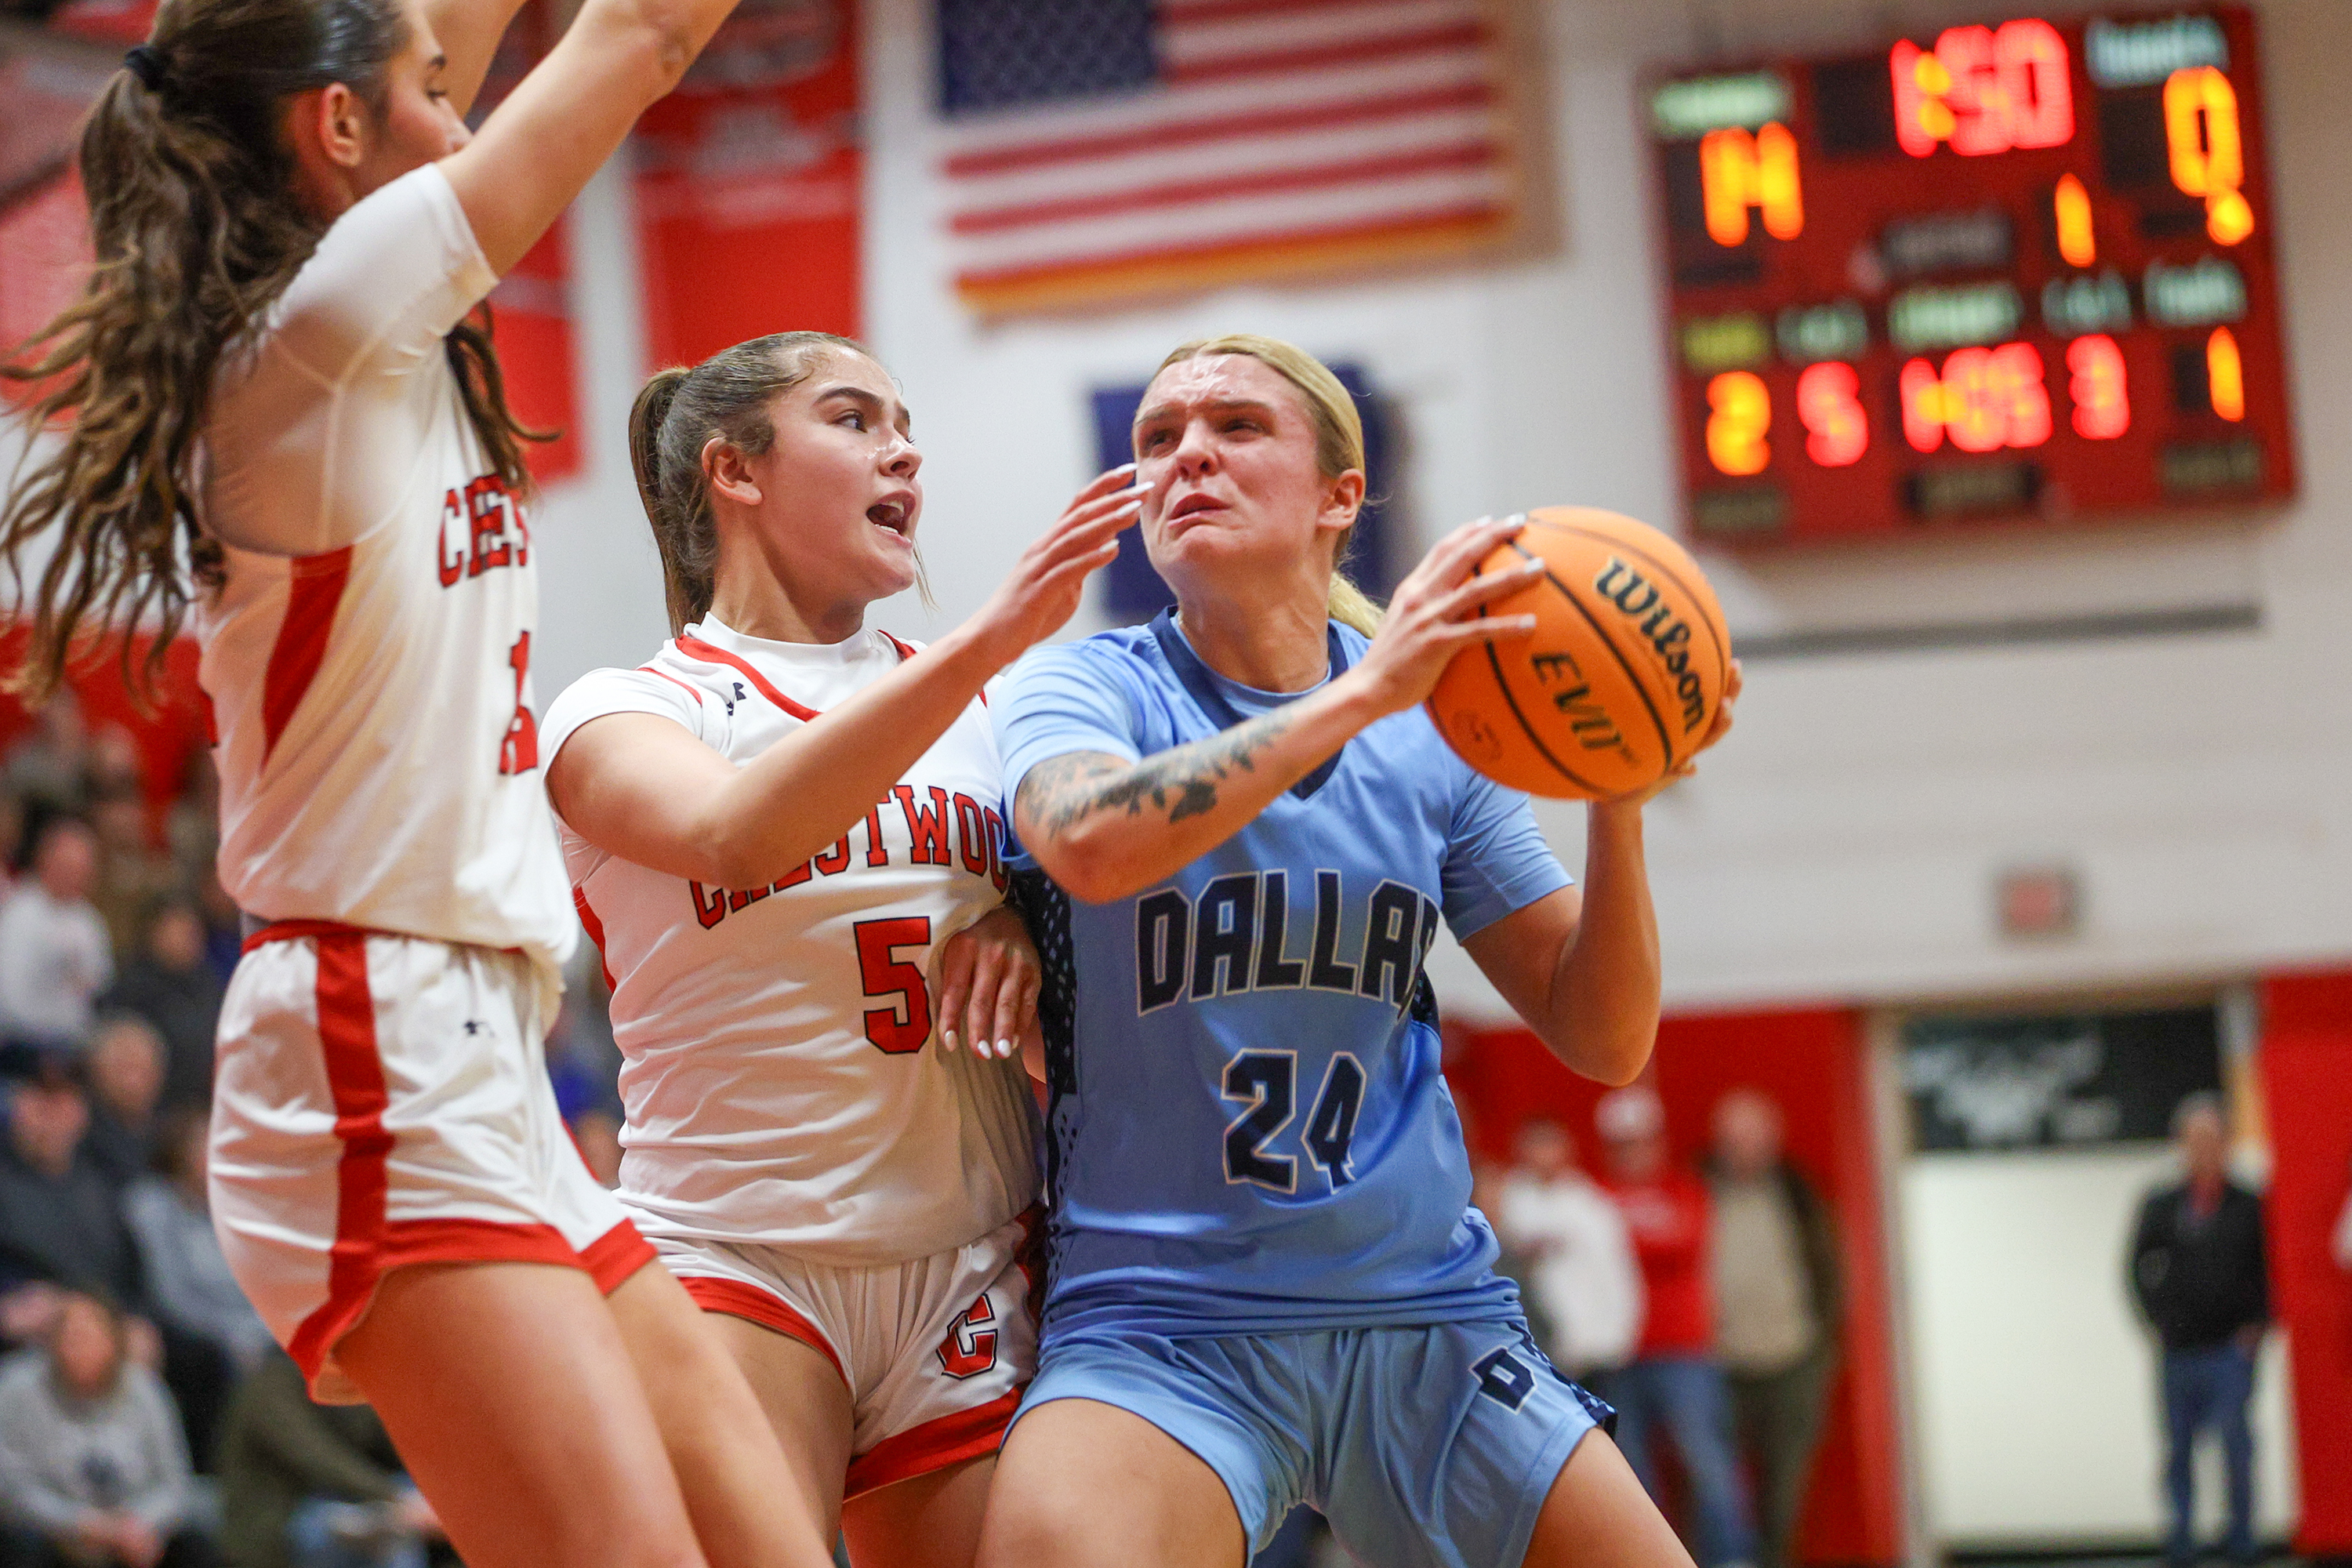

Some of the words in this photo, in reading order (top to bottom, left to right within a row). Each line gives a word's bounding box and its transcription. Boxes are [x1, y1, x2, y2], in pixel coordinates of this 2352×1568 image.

[1594, 555, 1708, 735] Wilson
[853, 916, 932, 1054] 5
[1221, 1047, 1367, 1195] 24
[1468, 1344, 1538, 1416] D
